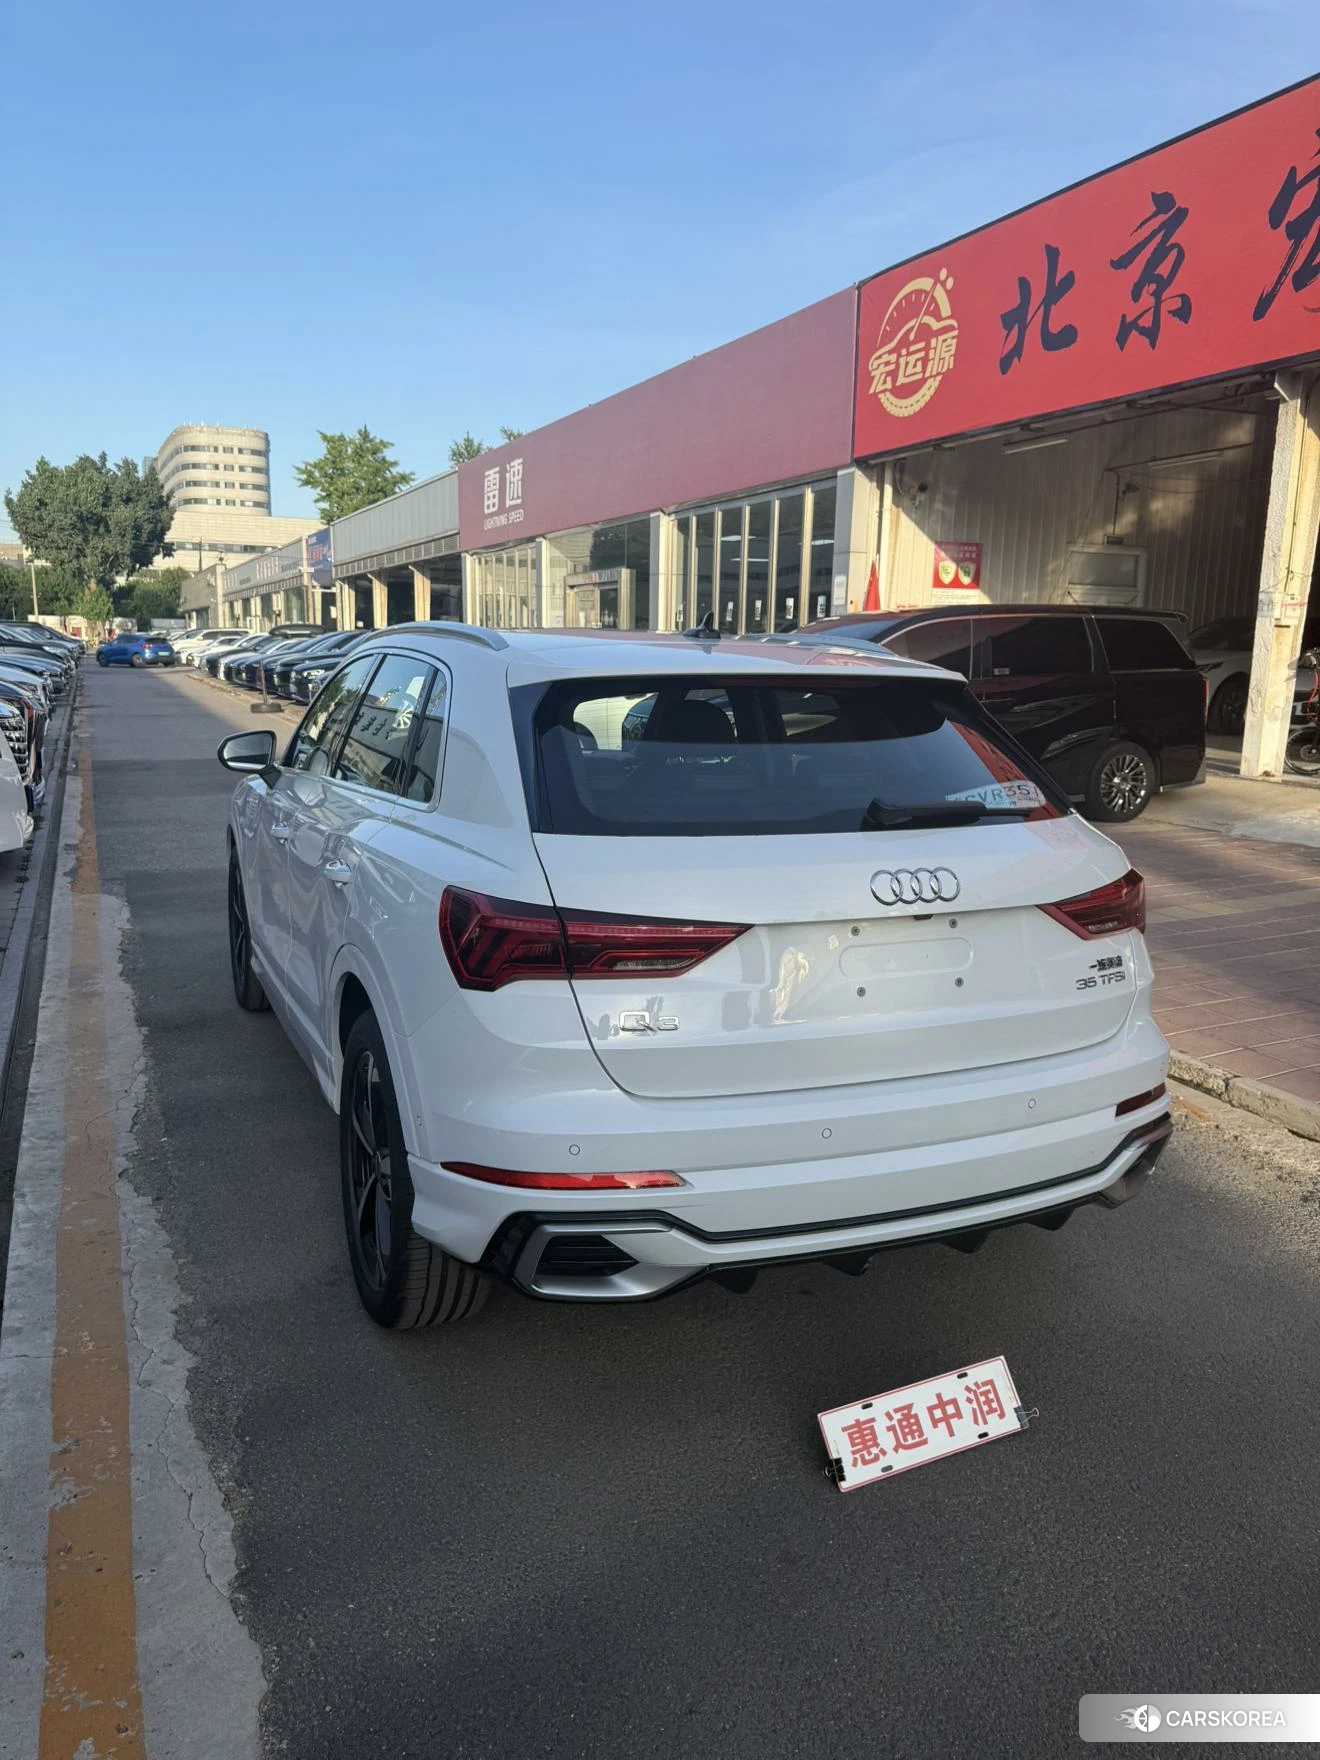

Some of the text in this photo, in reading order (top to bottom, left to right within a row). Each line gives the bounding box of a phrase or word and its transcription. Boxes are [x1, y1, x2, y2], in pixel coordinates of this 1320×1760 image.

[868, 330, 959, 395] 宏运源
[484, 458, 523, 514] 雷速
[484, 508, 524, 530] LIGHTNING SPEED
[1075, 971, 1126, 991] 35 TFSI
[619, 1011, 680, 1033] Q3
[841, 1378, 1007, 1469] 惠通中润
